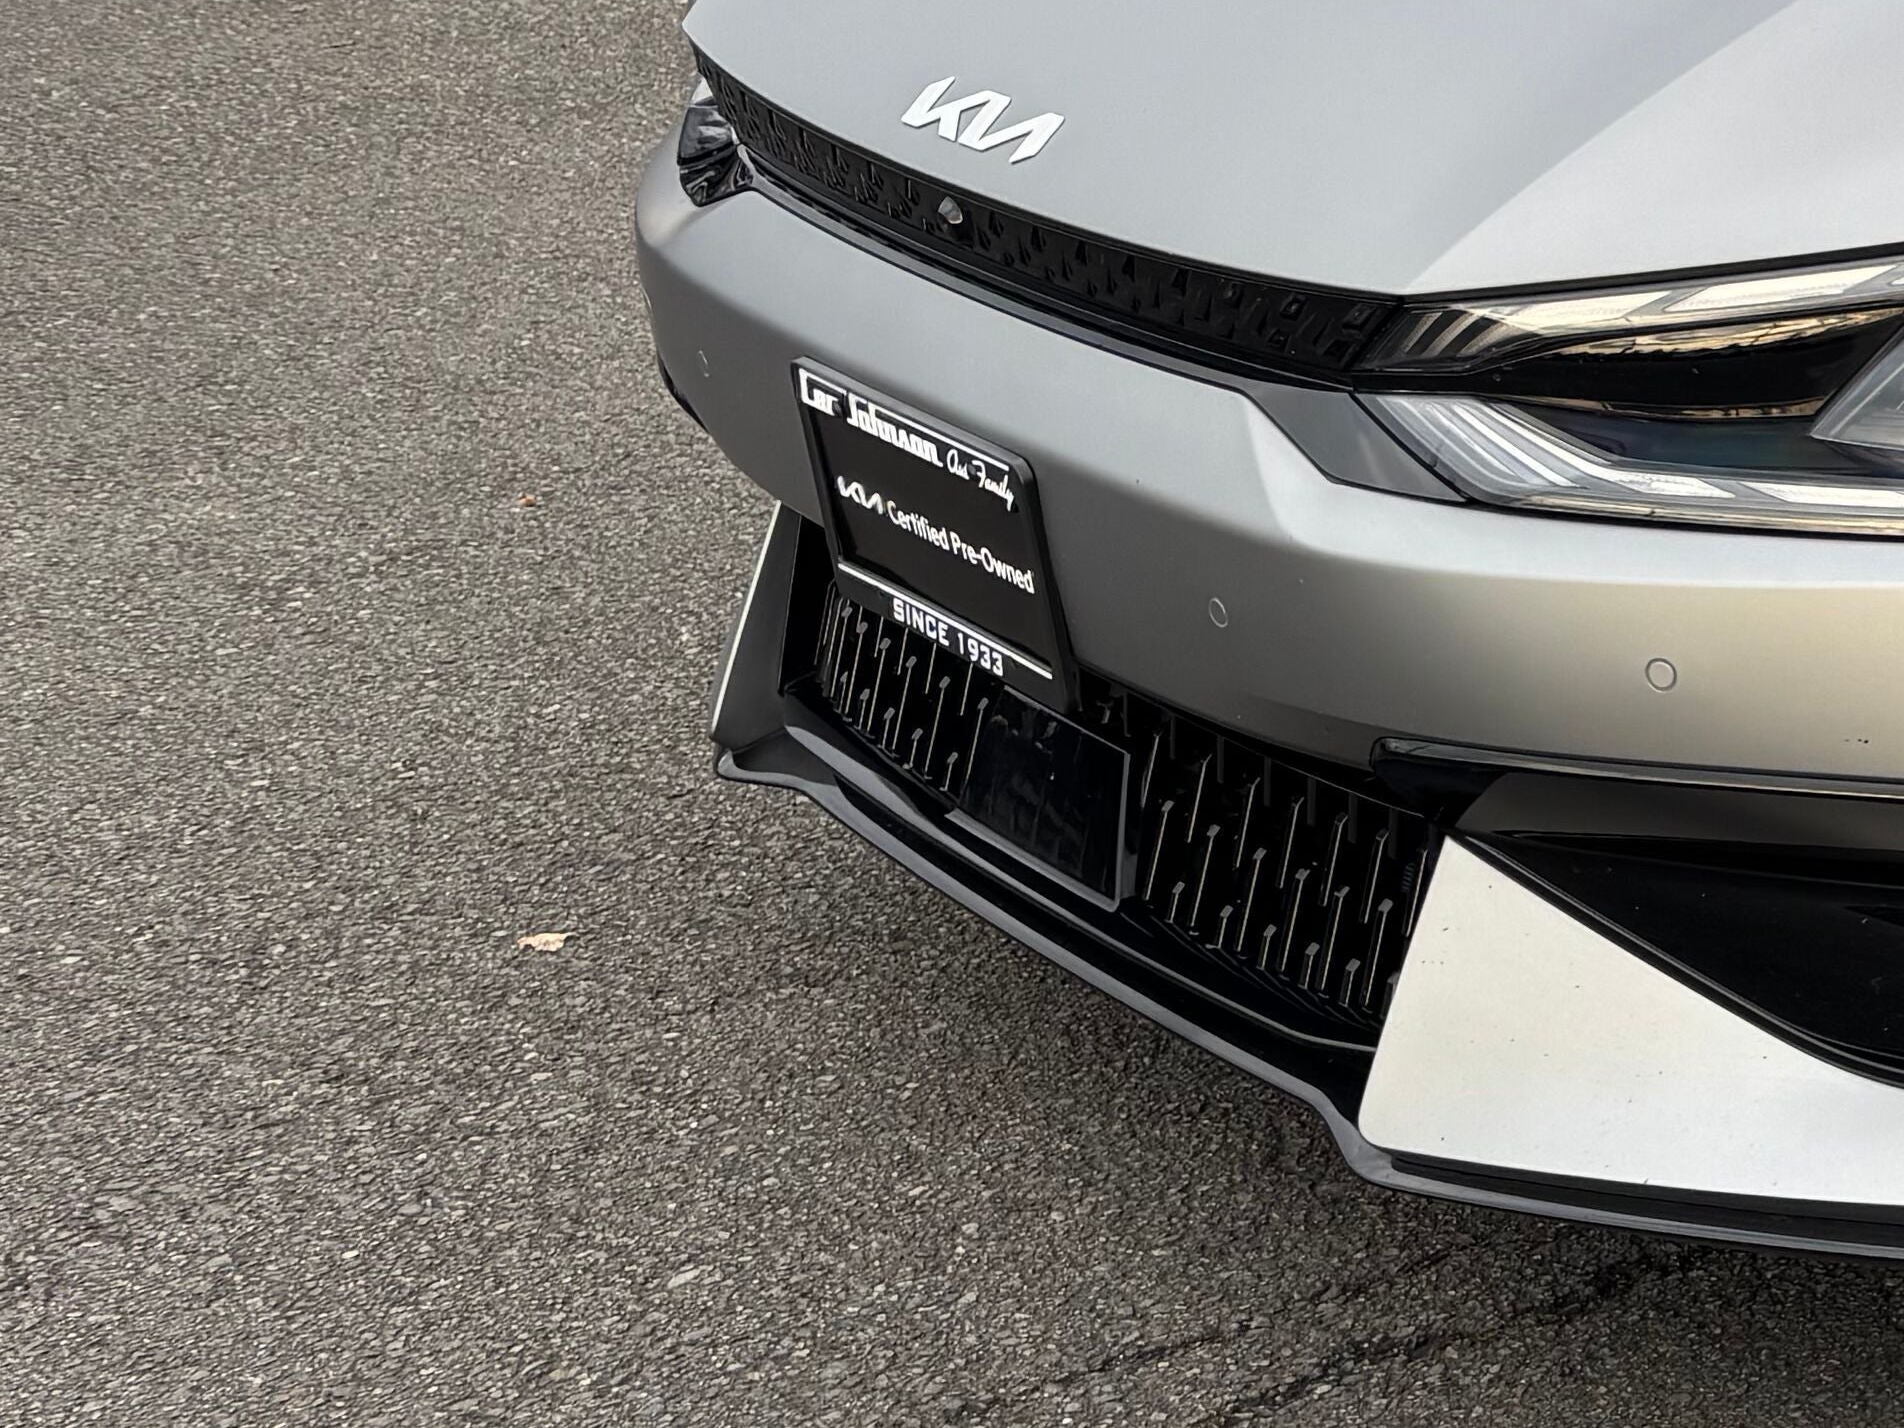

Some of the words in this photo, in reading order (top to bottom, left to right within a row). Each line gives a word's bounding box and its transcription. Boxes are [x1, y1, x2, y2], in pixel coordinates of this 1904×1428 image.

[901, 76, 1064, 161] KIA
[847, 393, 943, 467] Johnson
[971, 460, 1014, 511] Family
[837, 475, 884, 514] KIA
[887, 501, 950, 551] Certified
[950, 531, 1035, 594] Pre-Owned
[893, 597, 950, 647] SINCE
[957, 631, 1004, 677] 1933
